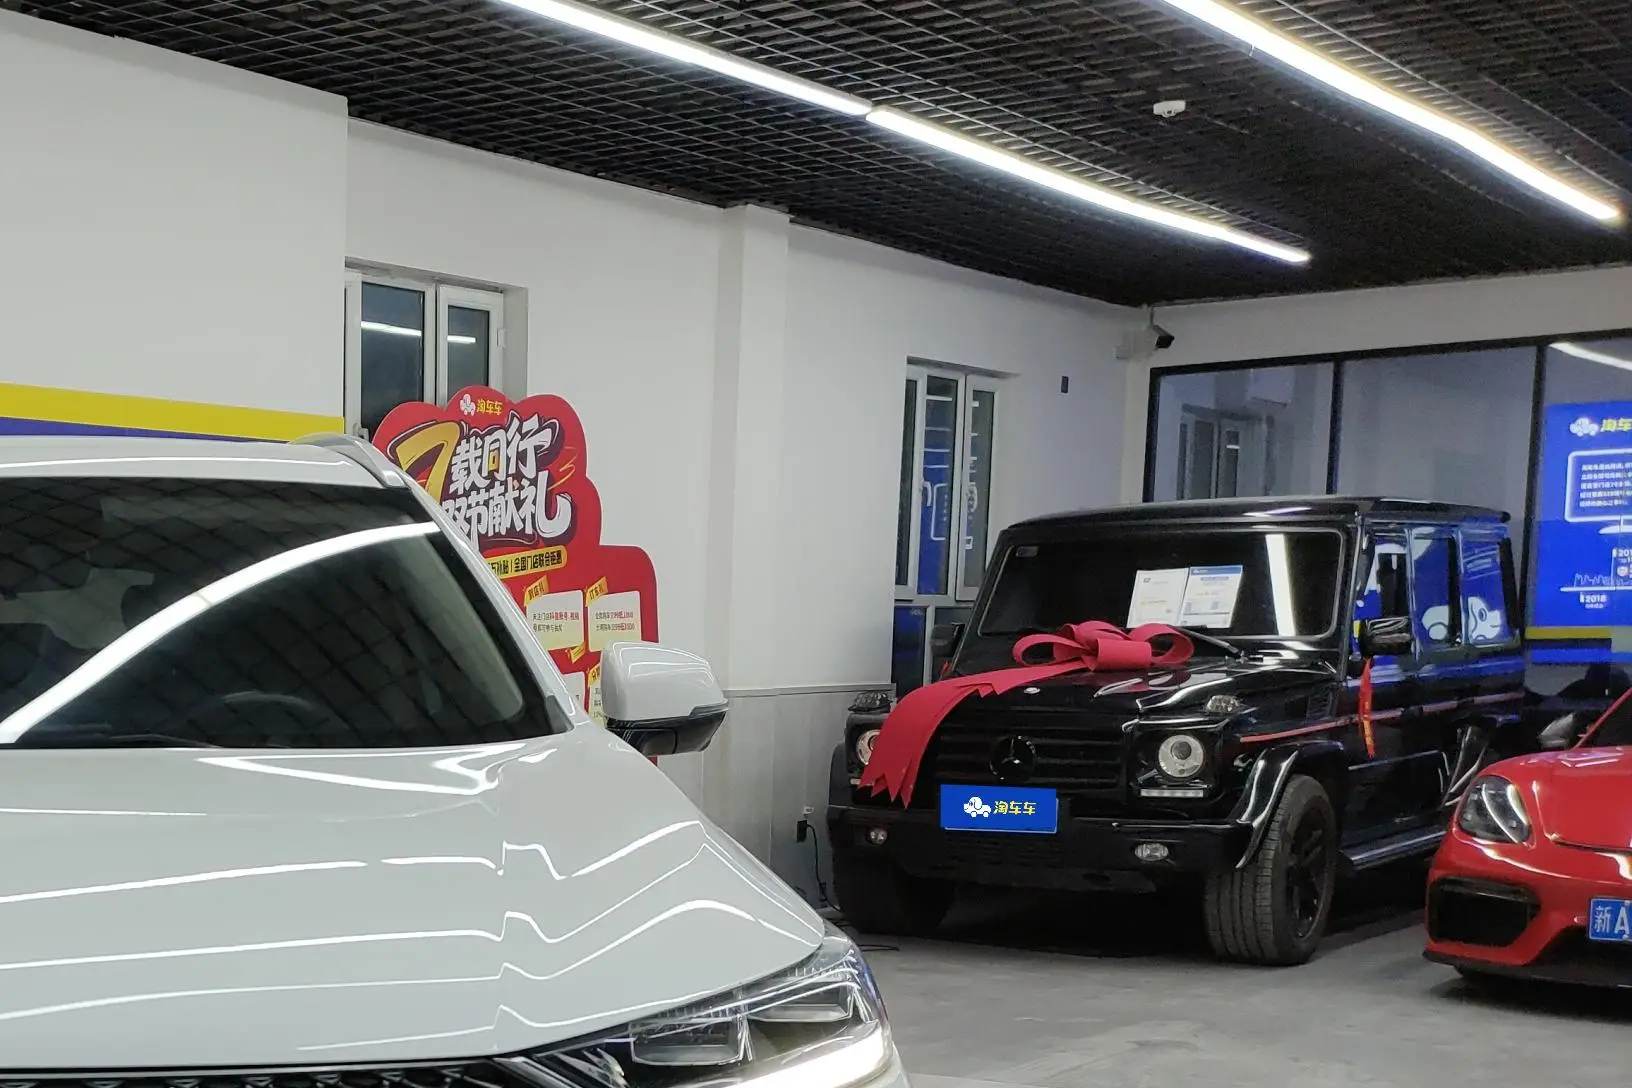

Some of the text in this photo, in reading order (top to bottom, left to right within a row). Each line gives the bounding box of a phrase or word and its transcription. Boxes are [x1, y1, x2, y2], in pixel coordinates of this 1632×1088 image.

[476, 399, 505, 416] 淘车车
[993, 800, 1037, 816] 淘车车
